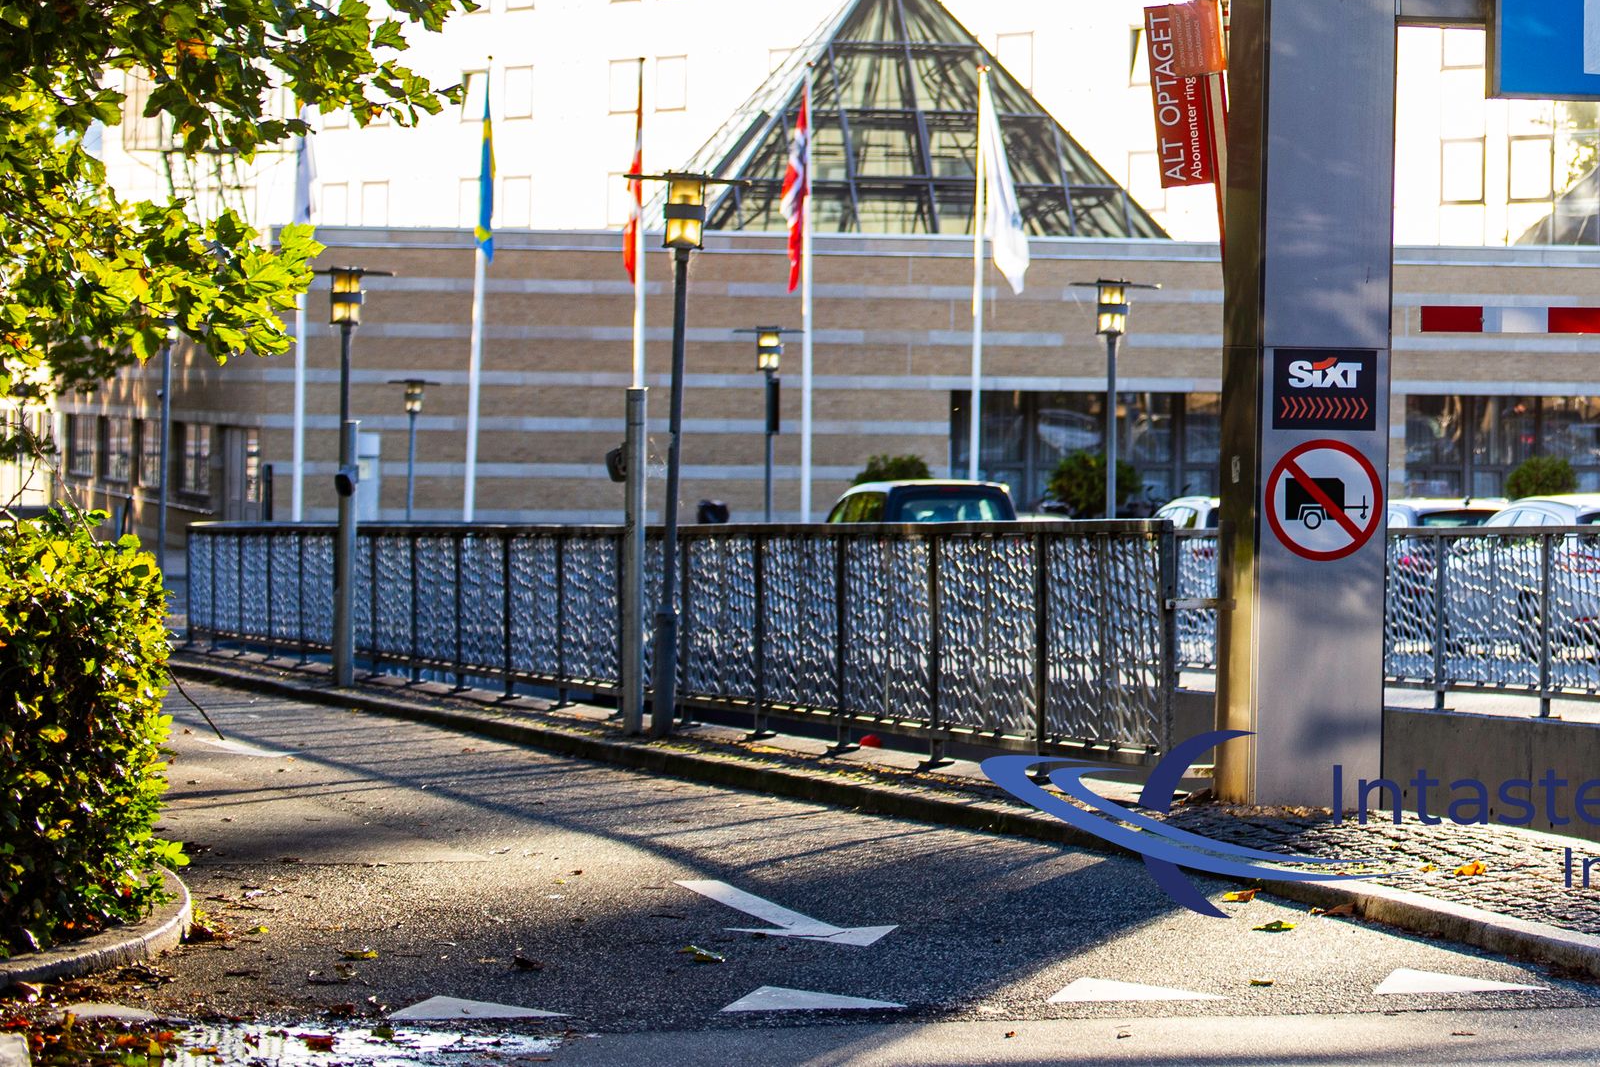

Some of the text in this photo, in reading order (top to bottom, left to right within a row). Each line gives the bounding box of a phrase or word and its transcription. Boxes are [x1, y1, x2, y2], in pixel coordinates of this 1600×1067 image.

[1149, 12, 1187, 181] ALT OPTAGET
[1188, 104, 1202, 179] Abonnenter
